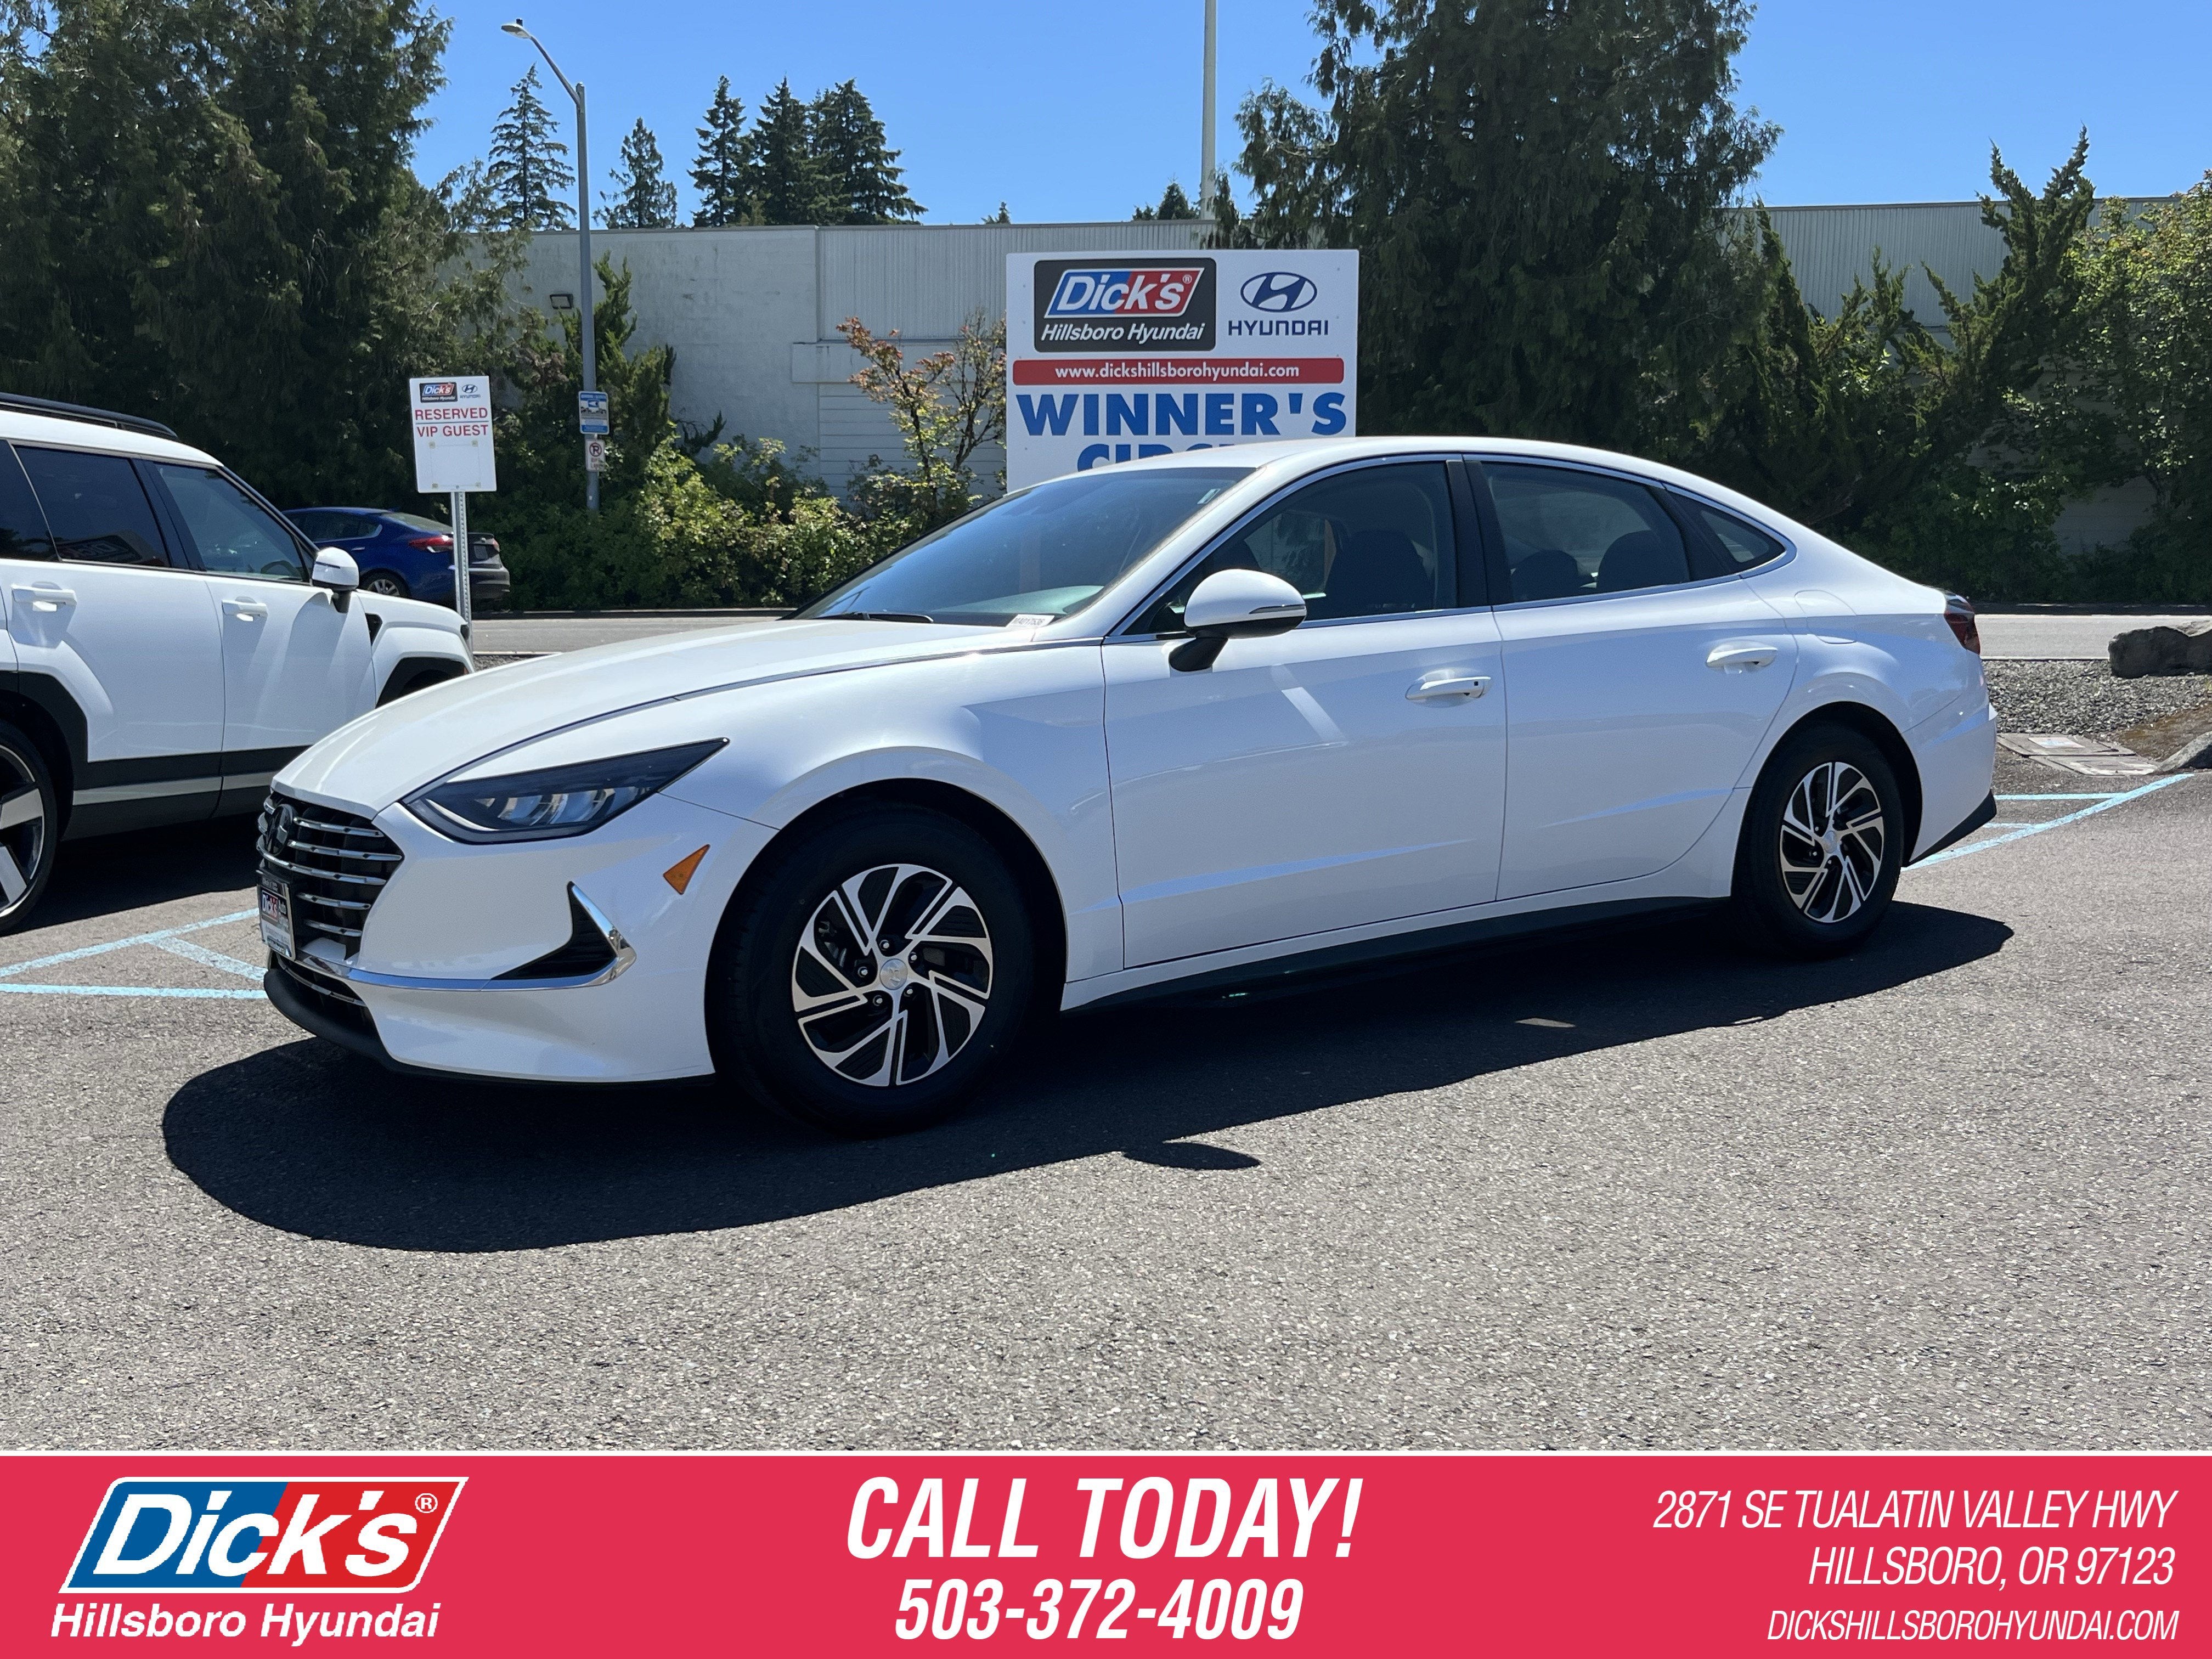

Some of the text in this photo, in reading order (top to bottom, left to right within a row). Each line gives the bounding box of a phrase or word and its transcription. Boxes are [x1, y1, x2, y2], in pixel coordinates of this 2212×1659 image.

[1056, 273, 1183, 311] Dick's
[1041, 322, 1205, 345] Hillsboro Hyundai
[1228, 319, 1328, 336] HYUNDAI
[1055, 362, 1300, 382] www.dickshillsborohyundai.com
[425, 385, 452, 394] Dick's
[415, 408, 488, 420] RESERVED
[1015, 392, 1346, 436] WINNER'S
[416, 424, 488, 437] VIP GUEST
